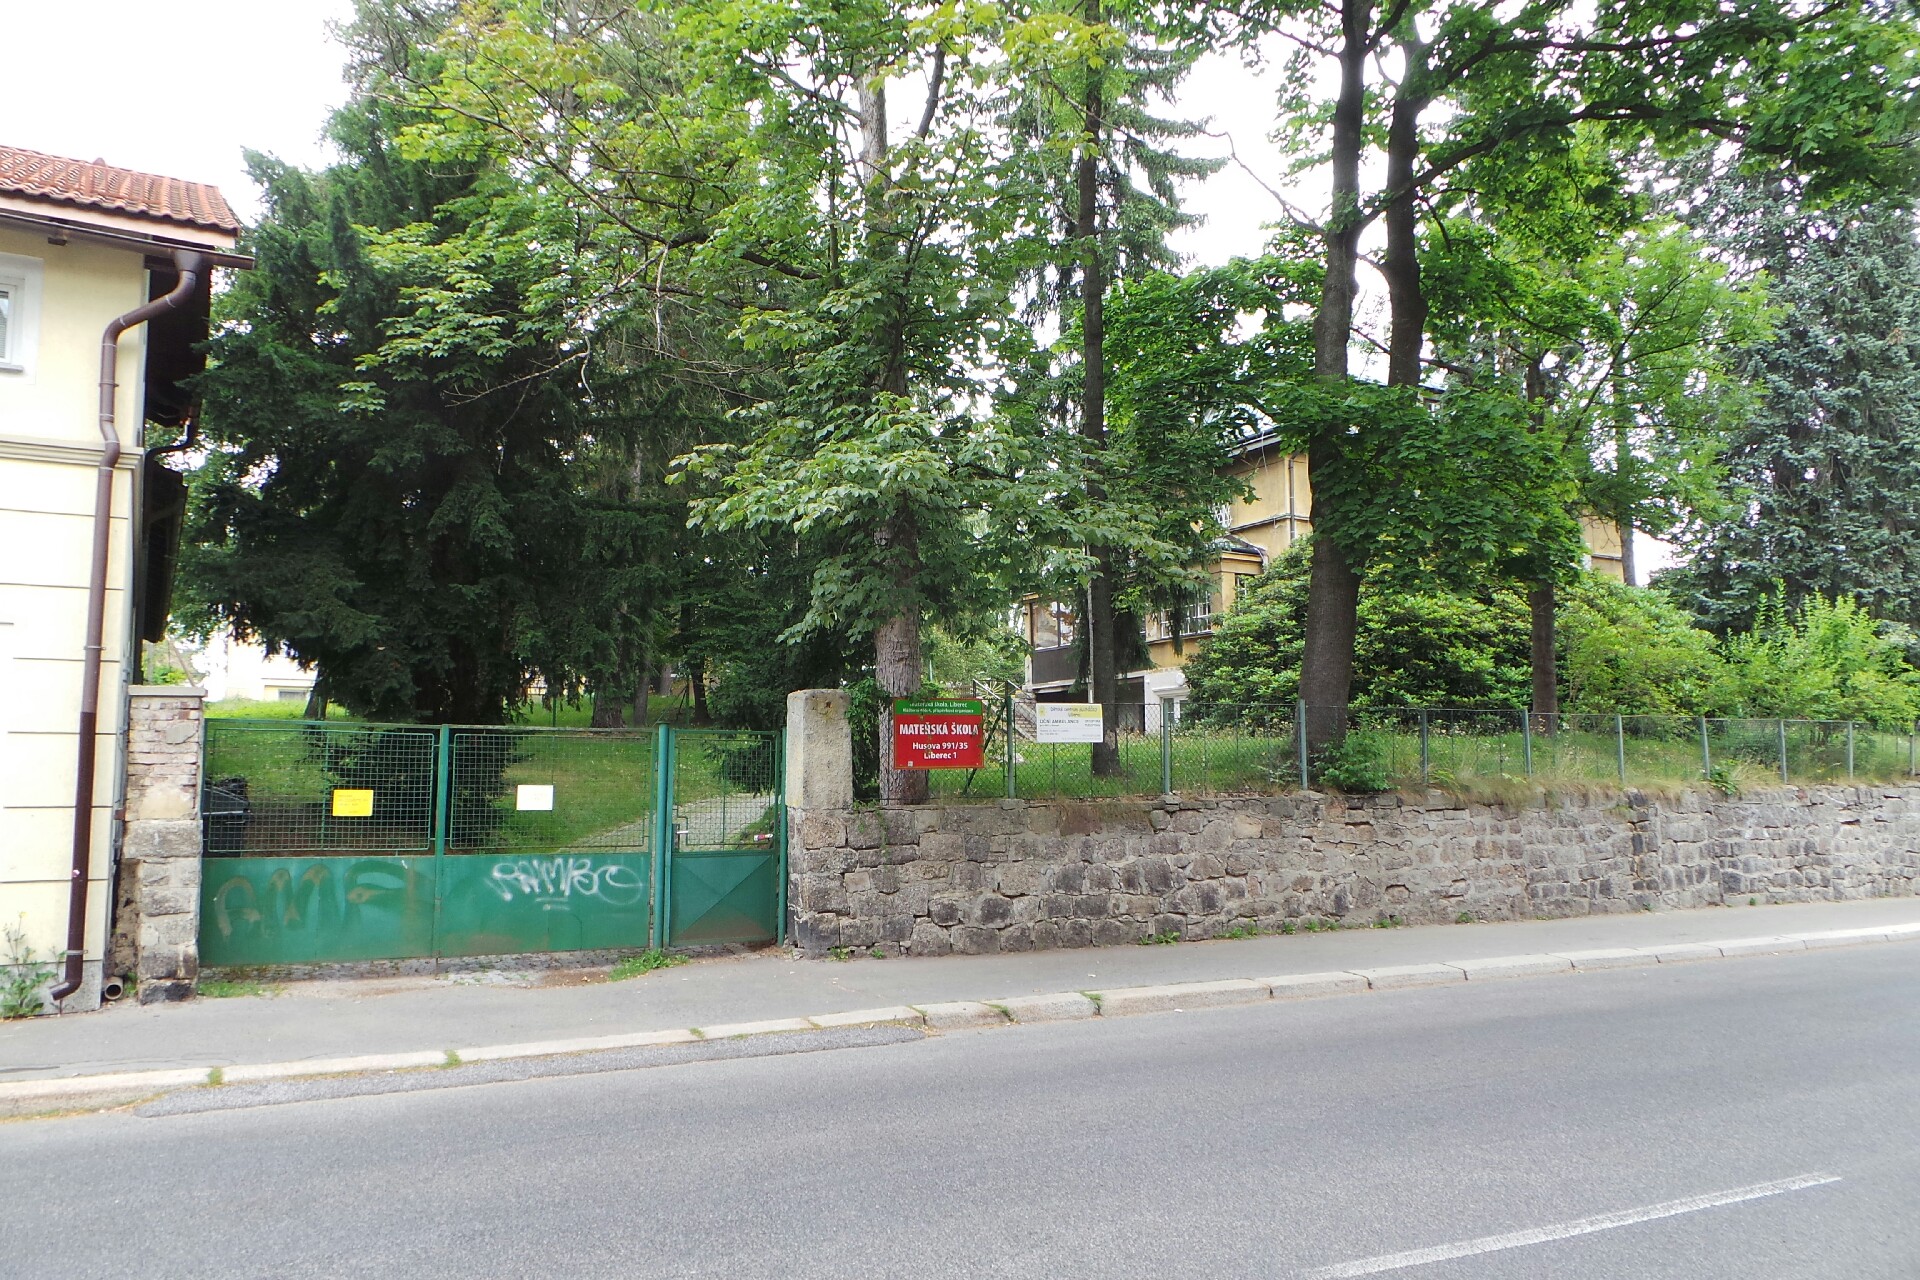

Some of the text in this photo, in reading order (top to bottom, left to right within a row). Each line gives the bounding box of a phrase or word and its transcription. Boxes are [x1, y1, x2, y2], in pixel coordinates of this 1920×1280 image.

[951, 722, 979, 735] ŠKOLA
[912, 742, 968, 750] Husova 991/35
